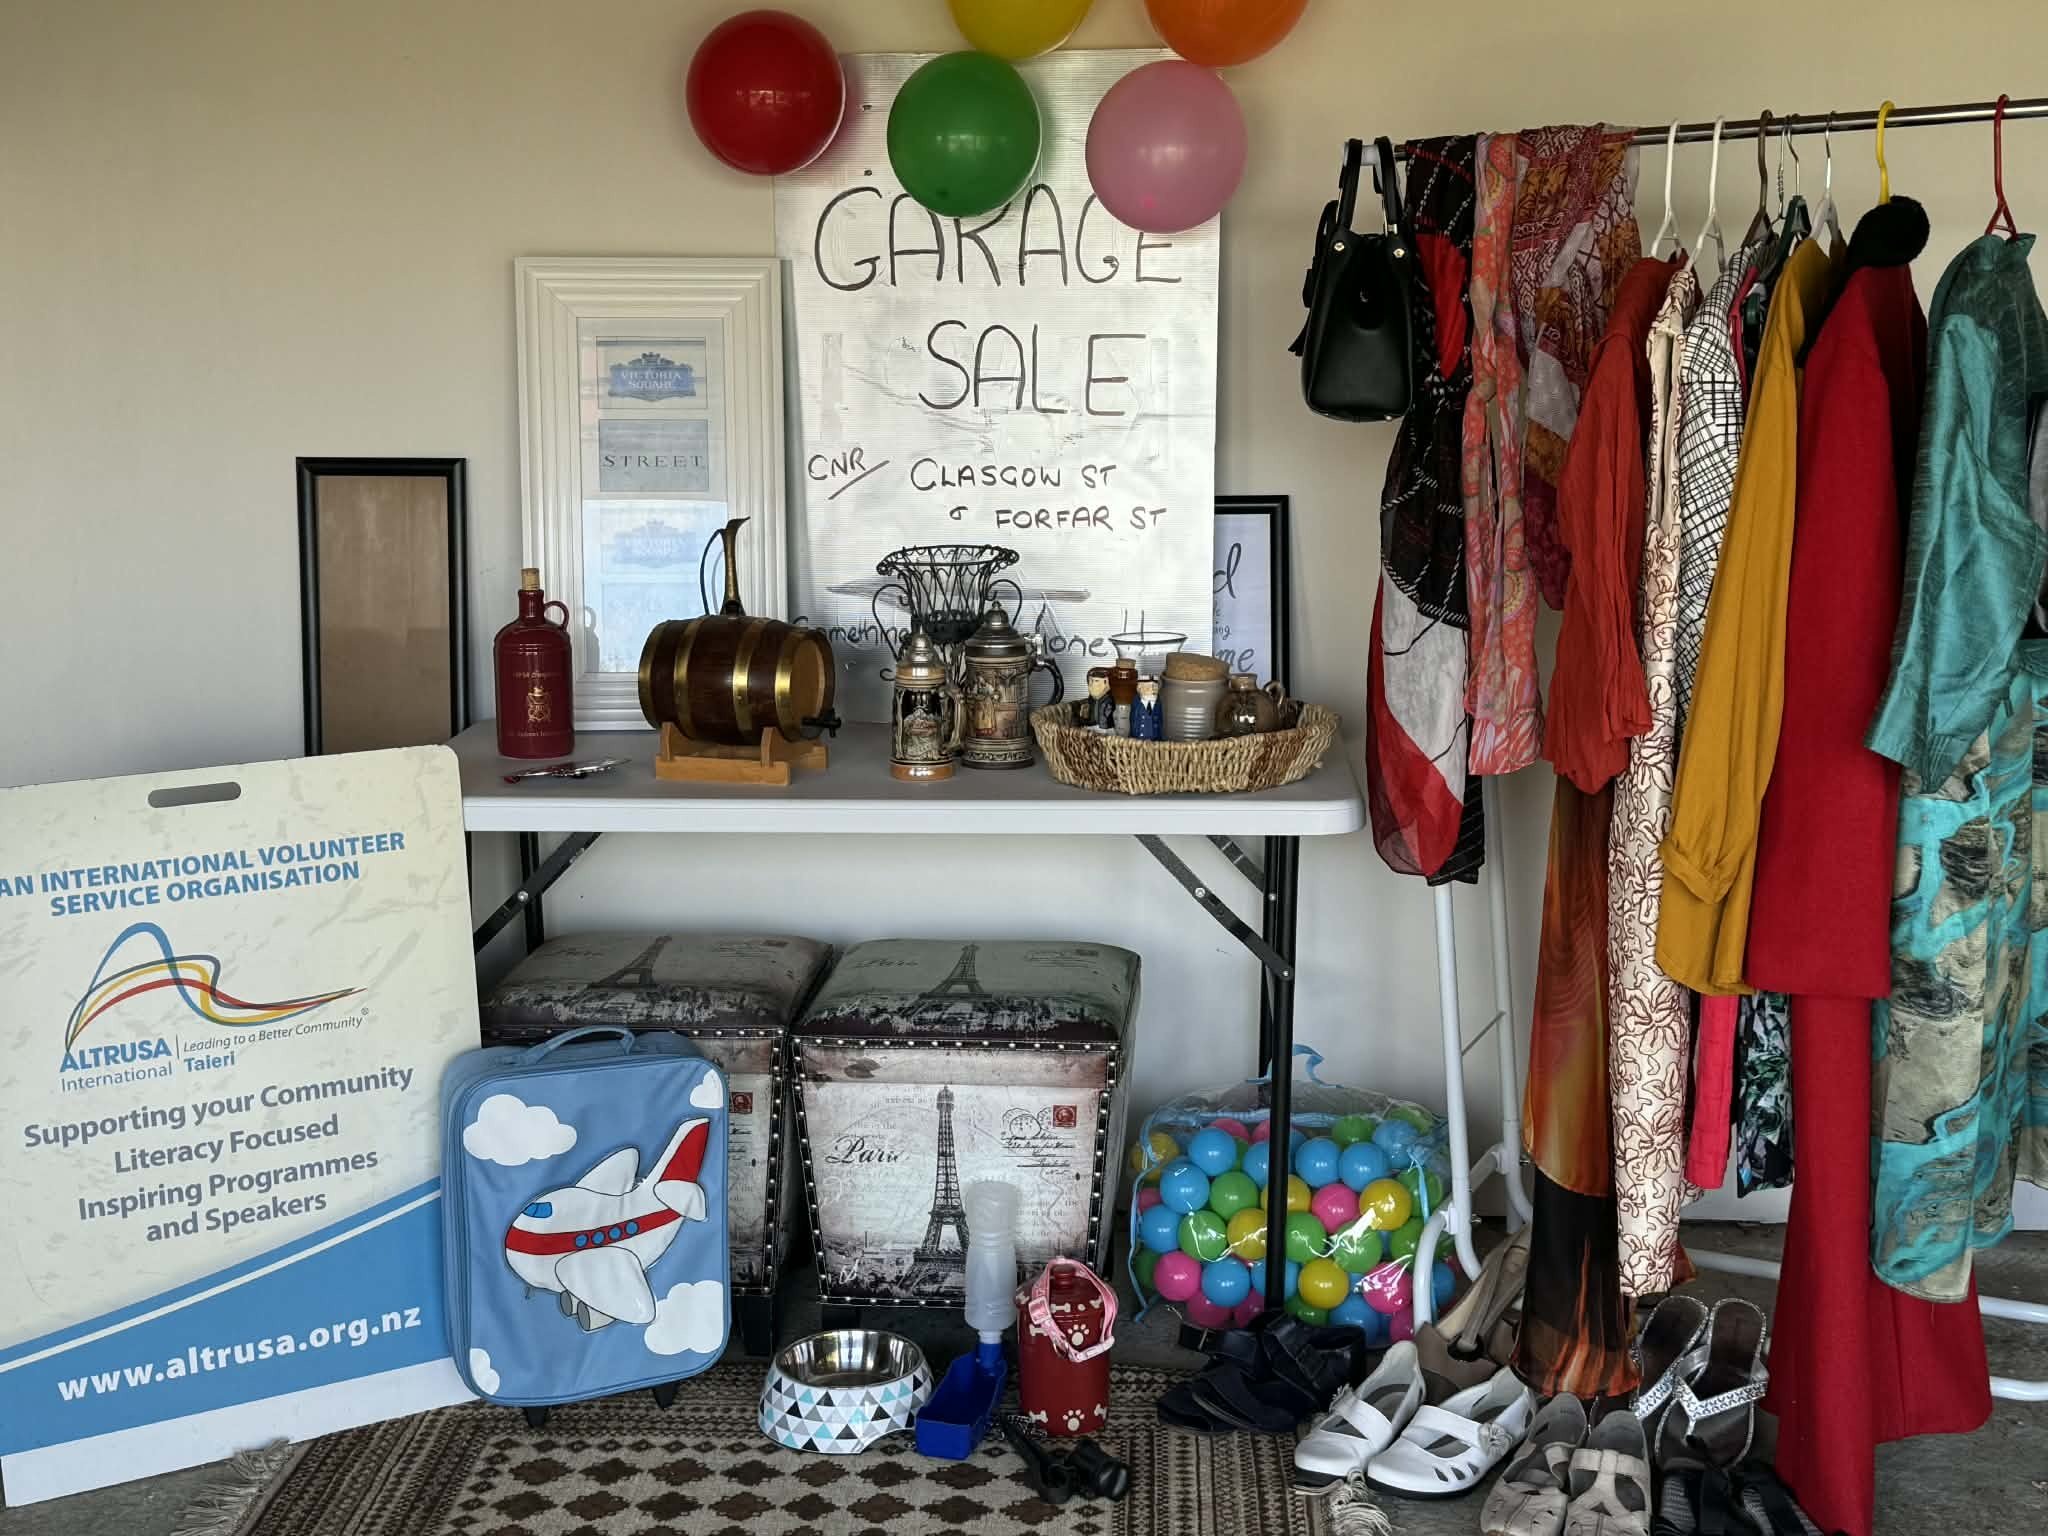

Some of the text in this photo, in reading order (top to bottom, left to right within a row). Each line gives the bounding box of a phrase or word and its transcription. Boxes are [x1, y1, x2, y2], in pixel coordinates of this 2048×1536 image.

[814, 183, 1182, 291] GARAGE
[918, 319, 1147, 417] SALE
[603, 455, 703, 468] STREET
[1081, 463, 1117, 489] ST
[995, 505, 1113, 532] FORFAR
[1130, 505, 1168, 530] ST
[0, 832, 405, 897] AN INTERNATIONAL VOLUNTEER
[51, 860, 360, 917] SERVICE ORGANISATION
[60, 1037, 172, 1073] ALTRUSA
[184, 1036, 231, 1053] Leading
[234, 1033, 246, 1046] to
[248, 1034, 256, 1043] a
[259, 1027, 294, 1042] Better
[184, 1051, 235, 1073] Taieri
[61, 1065, 173, 1092] International
[24, 1067, 414, 1147] Supporting your Community
[114, 1113, 339, 1173] Literacy Focused
[78, 1151, 378, 1220] Inspiring Programmes
[146, 1193, 327, 1242] and Speakers
[57, 1305, 422, 1401] www.altrusa.org.nz
